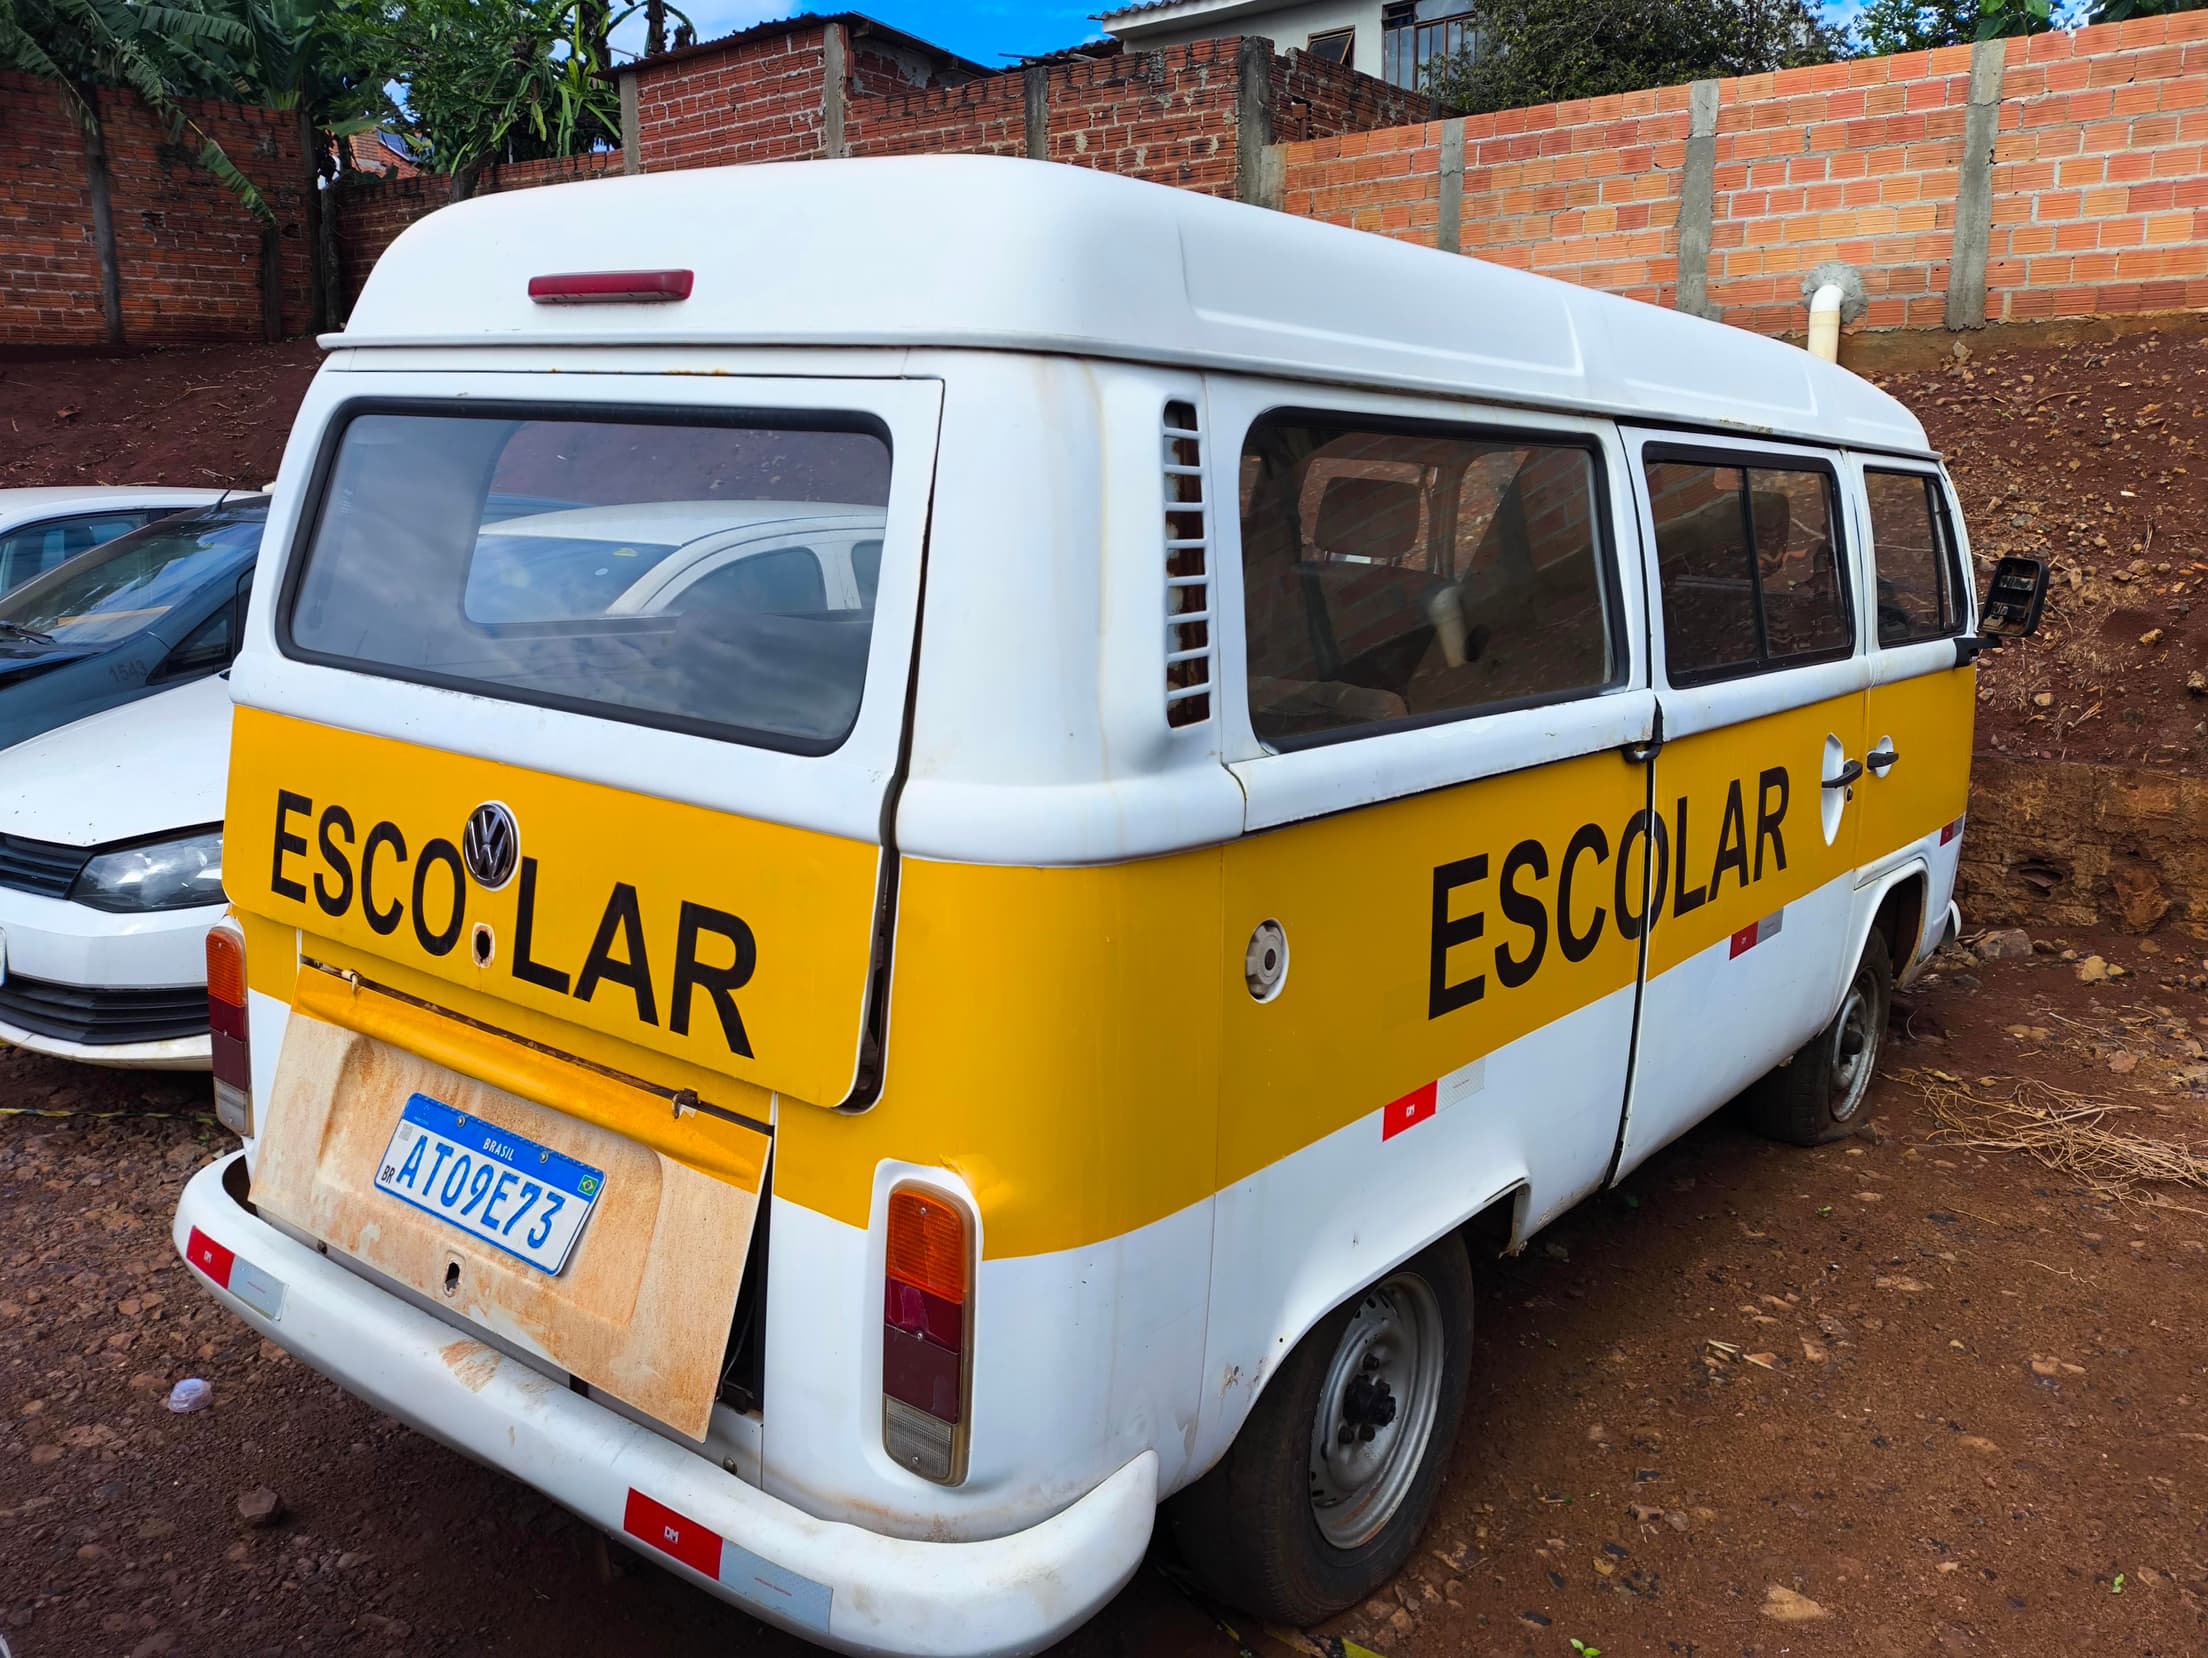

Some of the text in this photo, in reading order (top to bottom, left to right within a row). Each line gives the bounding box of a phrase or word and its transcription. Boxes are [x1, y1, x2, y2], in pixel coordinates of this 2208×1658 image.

[1428, 766, 1790, 1020] ESCOLAR
[483, 1137, 515, 1162] BRASIL
[381, 1165, 396, 1184] BR
[664, 1525, 679, 1544] DM
